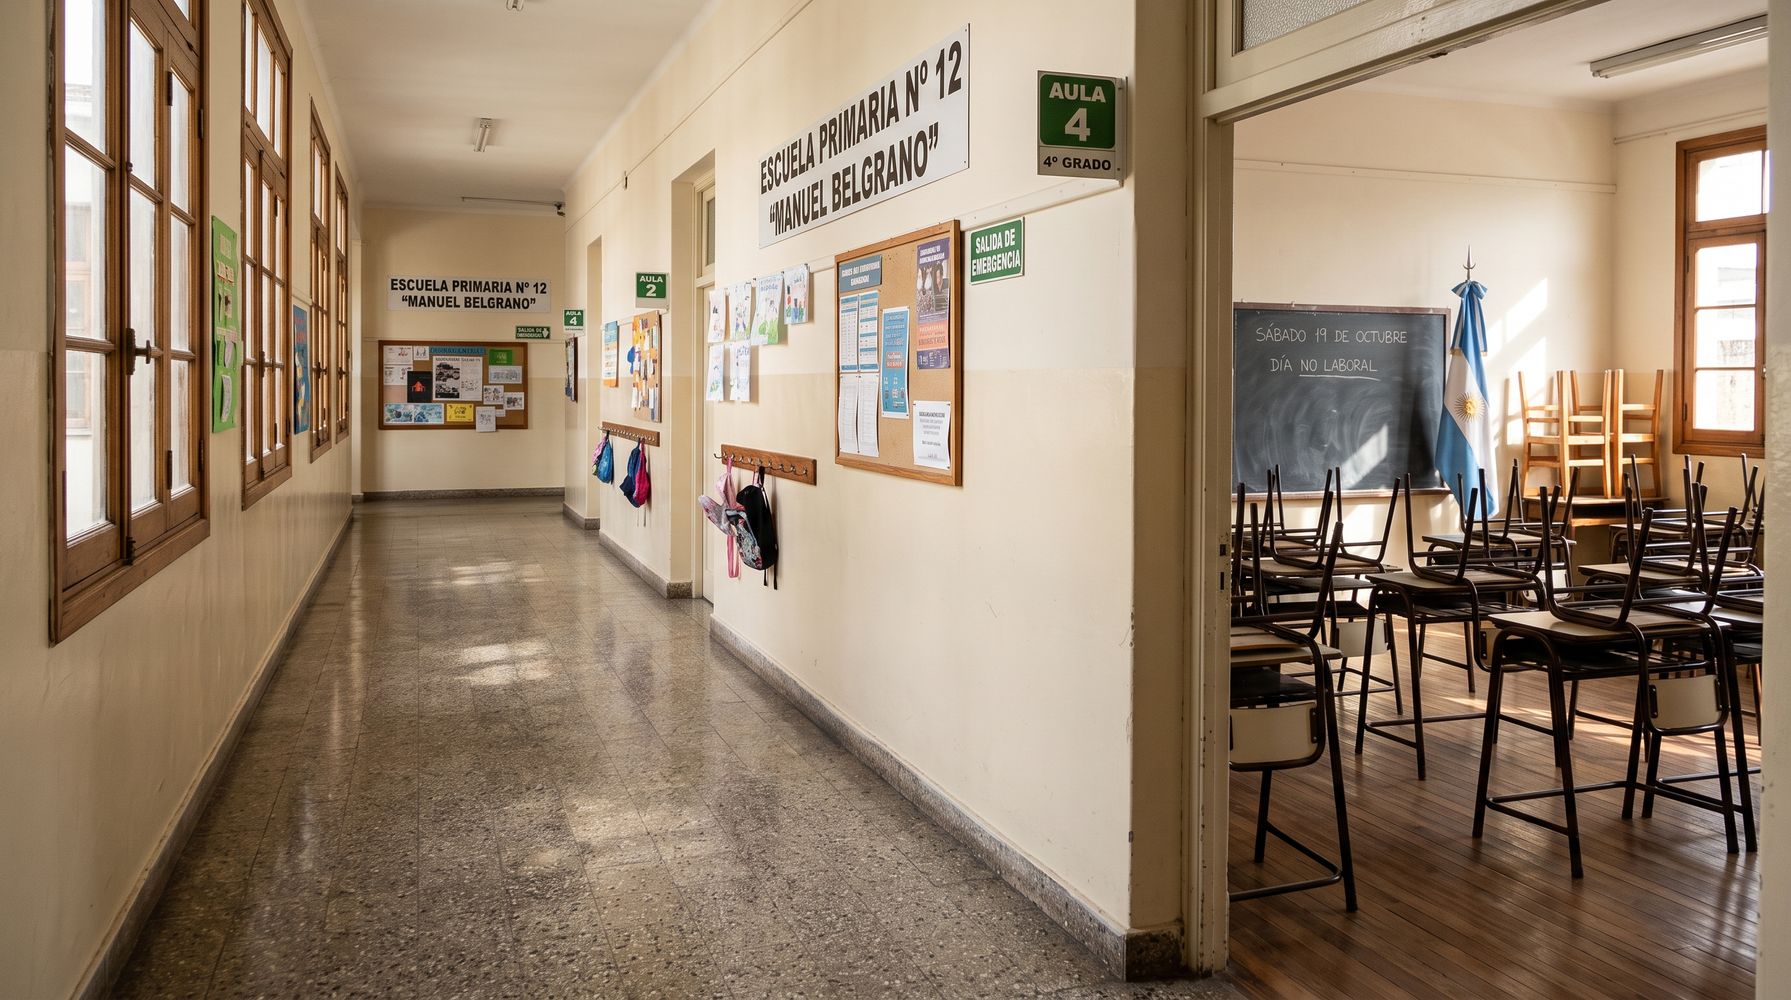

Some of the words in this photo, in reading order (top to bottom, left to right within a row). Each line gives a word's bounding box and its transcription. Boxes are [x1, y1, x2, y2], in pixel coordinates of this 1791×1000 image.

[1048, 82, 1106, 103] AULA
[760, 130, 815, 194] ESCUELA
[818, 79, 900, 164] PRIMARIA
[905, 60, 928, 117] Nº
[935, 40, 962, 100] 12
[1064, 107, 1091, 141] 4
[1043, 157, 1058, 167] 4º
[1062, 157, 1112, 171] GRADO
[769, 181, 827, 236] “MANUEL
[832, 121, 939, 213] BELGRANO”
[975, 231, 1002, 253] SALIDA
[1005, 228, 1016, 245] DE
[972, 248, 1021, 276] EMERGENCIA
[390, 279, 449, 292] ESCUELA
[452, 280, 513, 294] PRIMARIA
[516, 281, 530, 294] Nº
[533, 282, 547, 295] 12
[646, 284, 657, 297] 2
[402, 295, 461, 308] “MANUEL
[464, 296, 536, 310] BELGRANO”
[569, 316, 577, 326] 4
[1256, 323, 1307, 342] SÁBADO
[1315, 327, 1327, 343] 19
[1334, 330, 1349, 343] DE
[1356, 330, 1408, 344] OCTUBRE
[1270, 354, 1293, 372] DÍA
[1300, 358, 1317, 371] NO
[1324, 358, 1378, 372] LABORAL
